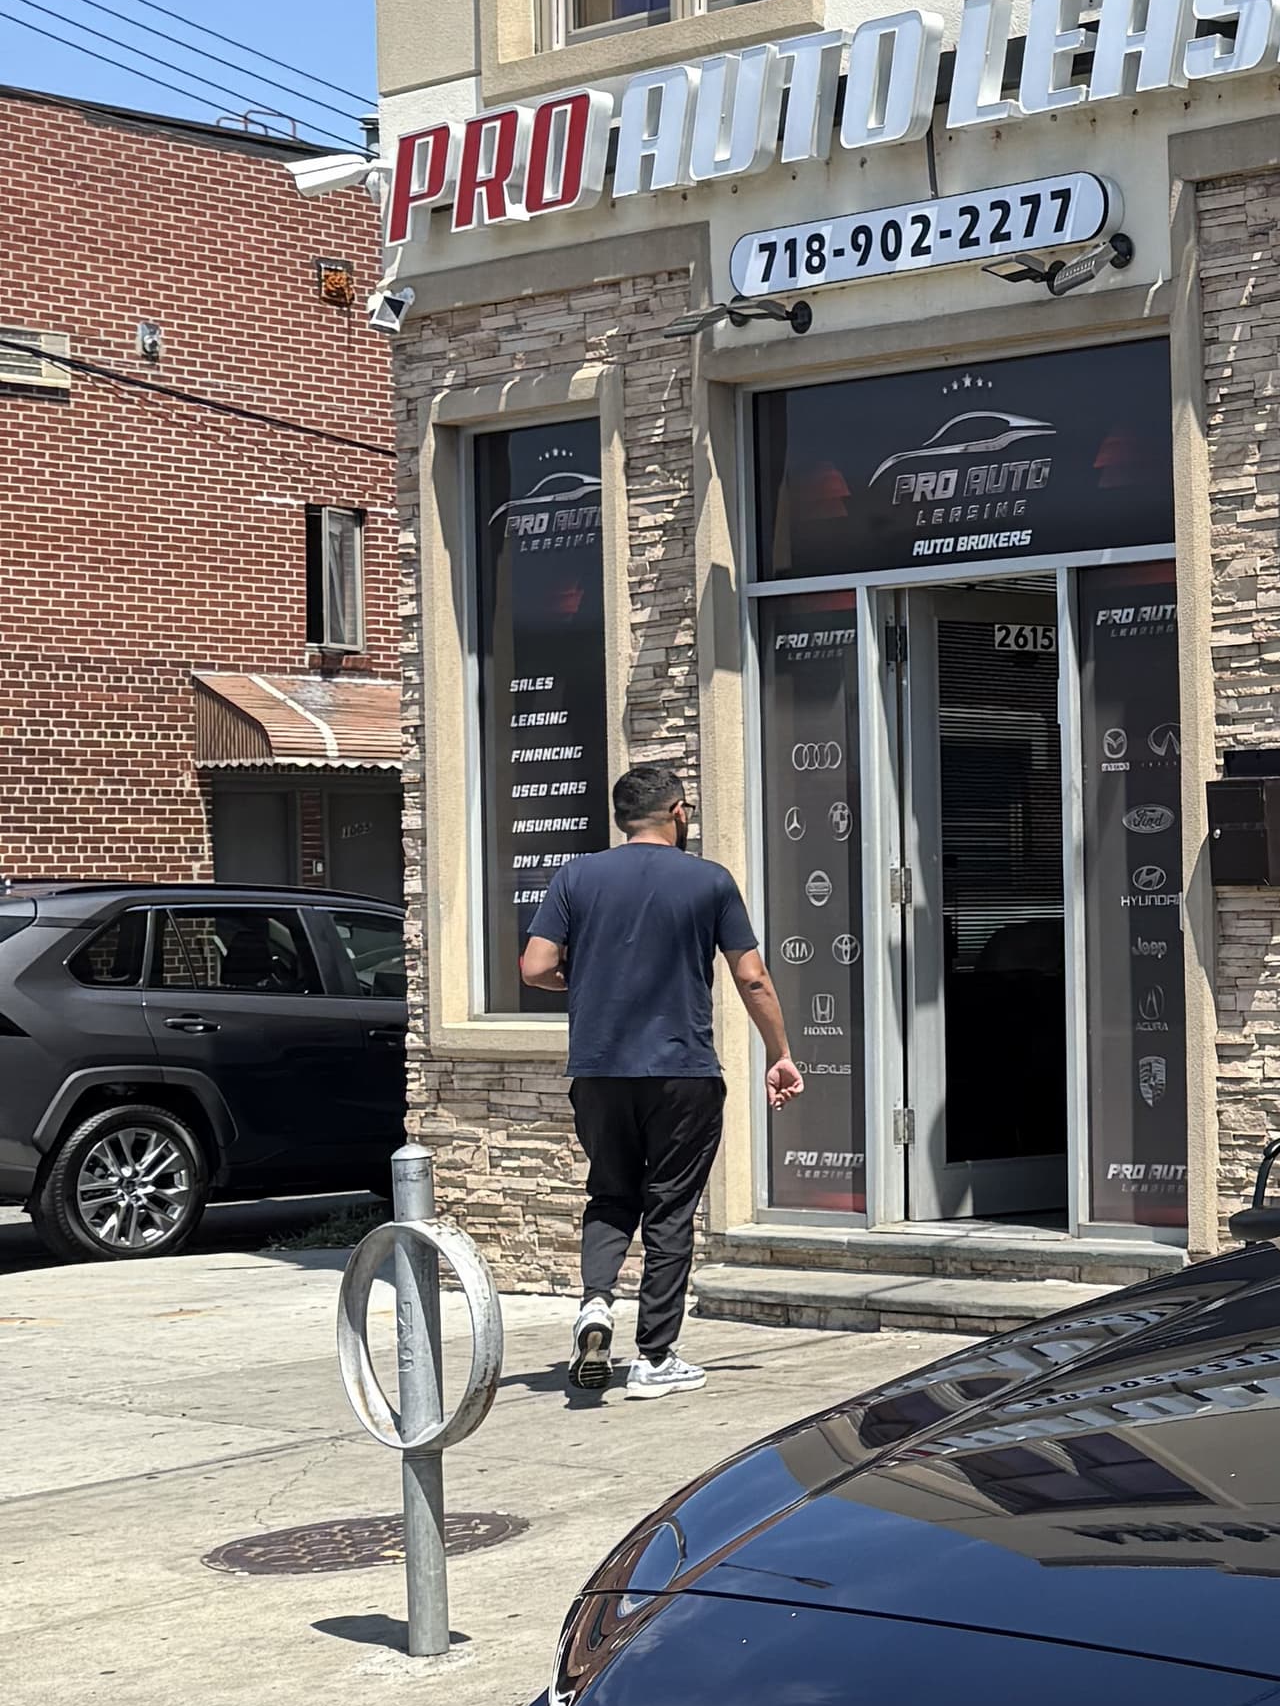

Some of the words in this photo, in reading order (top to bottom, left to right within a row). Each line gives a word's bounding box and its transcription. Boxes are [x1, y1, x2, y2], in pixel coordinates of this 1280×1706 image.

[386, 86, 613, 245] PRO
[612, 9, 945, 198] AUTO
[758, 186, 1075, 283] 718-902-2277
[891, 467, 960, 505] PRO
[963, 457, 1053, 498] AUTO
[915, 498, 1030, 528] LEASING
[503, 512, 550, 539] PRO
[519, 532, 597, 553] LEASING
[911, 536, 956, 557] AUTO
[956, 528, 1034, 554] BROKERS
[1095, 607, 1136, 626] PRO
[1137, 604, 1177, 622] AUT
[775, 633, 810, 650] PRO
[811, 628, 856, 647] AUTO
[996, 624, 1055, 651] 2615
[509, 676, 555, 693] SALES
[510, 711, 569, 728] LEASING
[511, 745, 584, 763] FINANCING
[511, 783, 548, 799] USED
[550, 781, 588, 796] CARS
[512, 816, 590, 834] INSURANCE
[512, 854, 540, 870] DMV
[1120, 894, 1180, 907] HYUNDA
[786, 942, 808, 958] KIA
[1132, 937, 1168, 958] Jeep
[803, 1026, 844, 1036] HONDA
[808, 1063, 852, 1075] LEXUS
[783, 1150, 819, 1166] PRO
[1106, 1163, 1146, 1180] PRO
[1147, 1163, 1187, 1181] AUT
